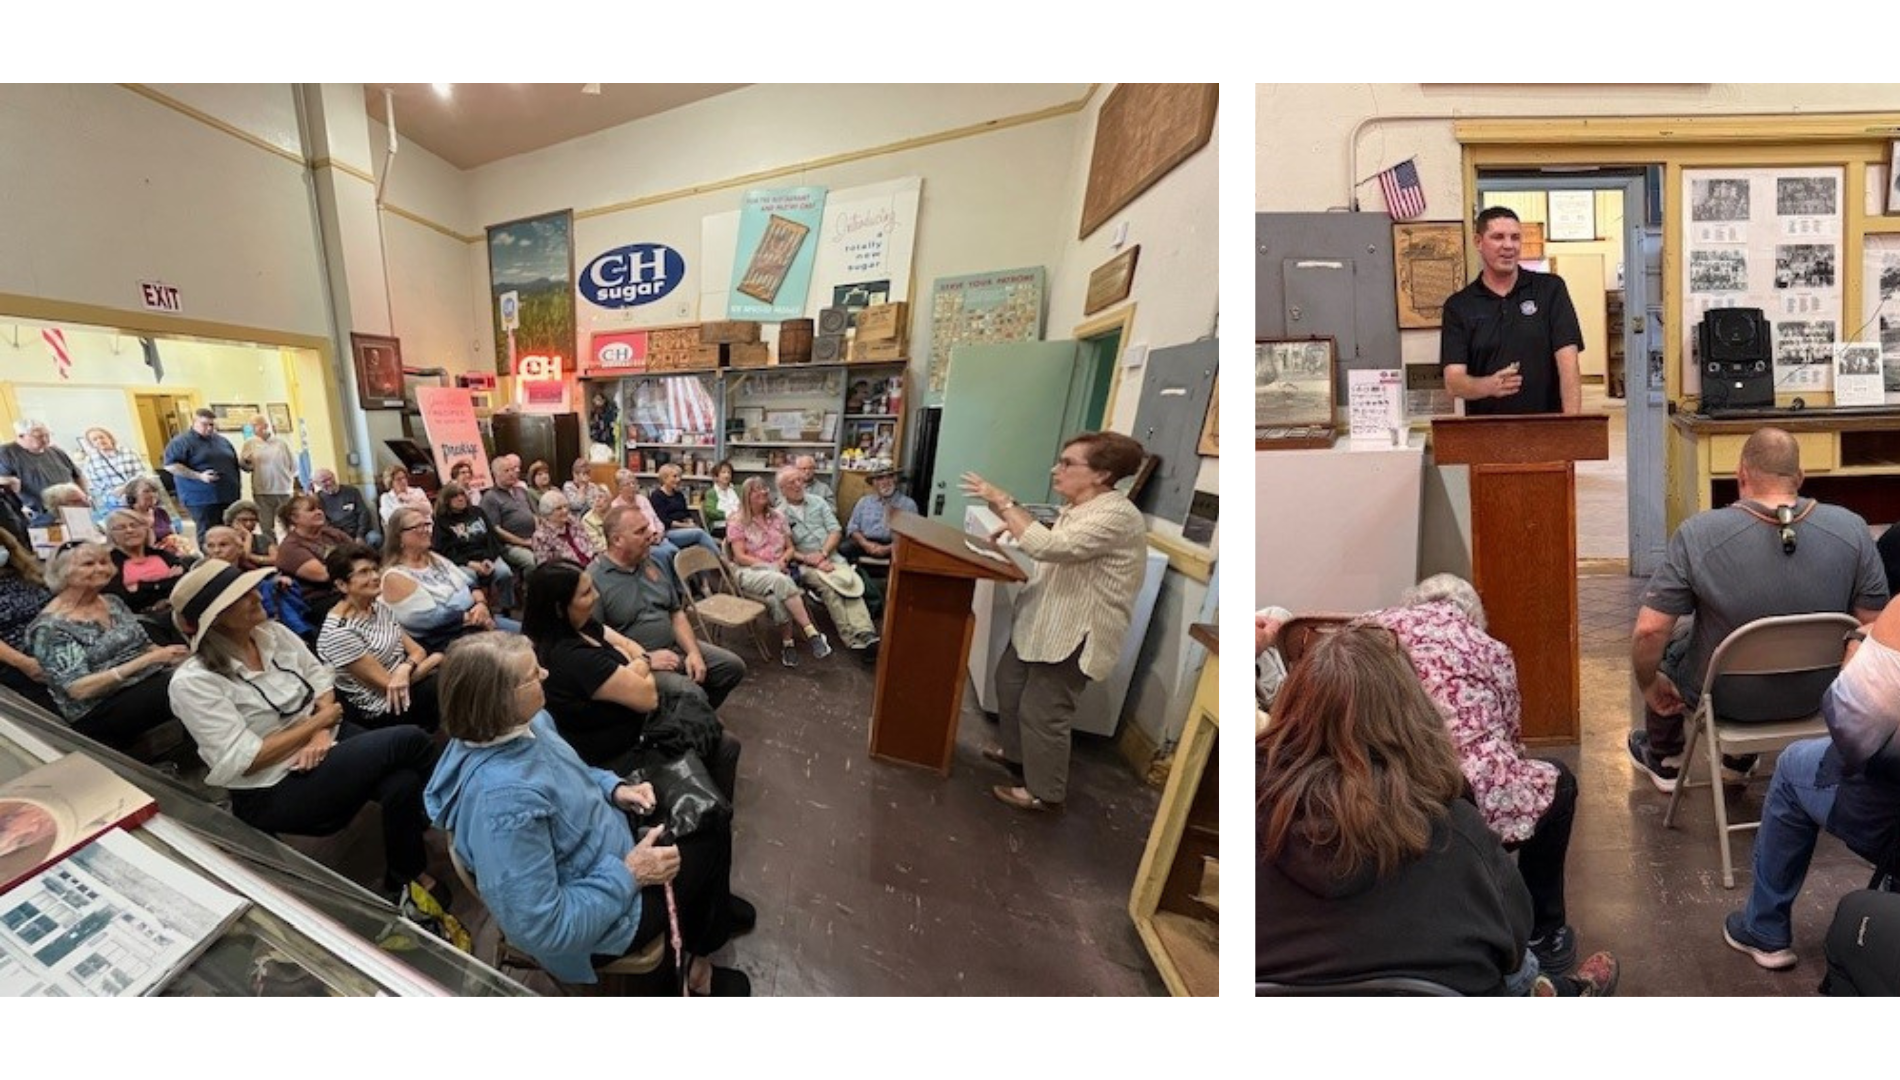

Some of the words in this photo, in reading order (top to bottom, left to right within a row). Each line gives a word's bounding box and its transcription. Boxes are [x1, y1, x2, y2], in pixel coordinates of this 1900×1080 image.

[833, 206, 901, 242] Introducing
[845, 240, 882, 252] totally
[855, 251, 881, 259] new
[847, 261, 881, 272] sugar
[969, 279, 992, 288] YOUR
[142, 284, 180, 310] EXIT
[597, 281, 665, 302] sugar
